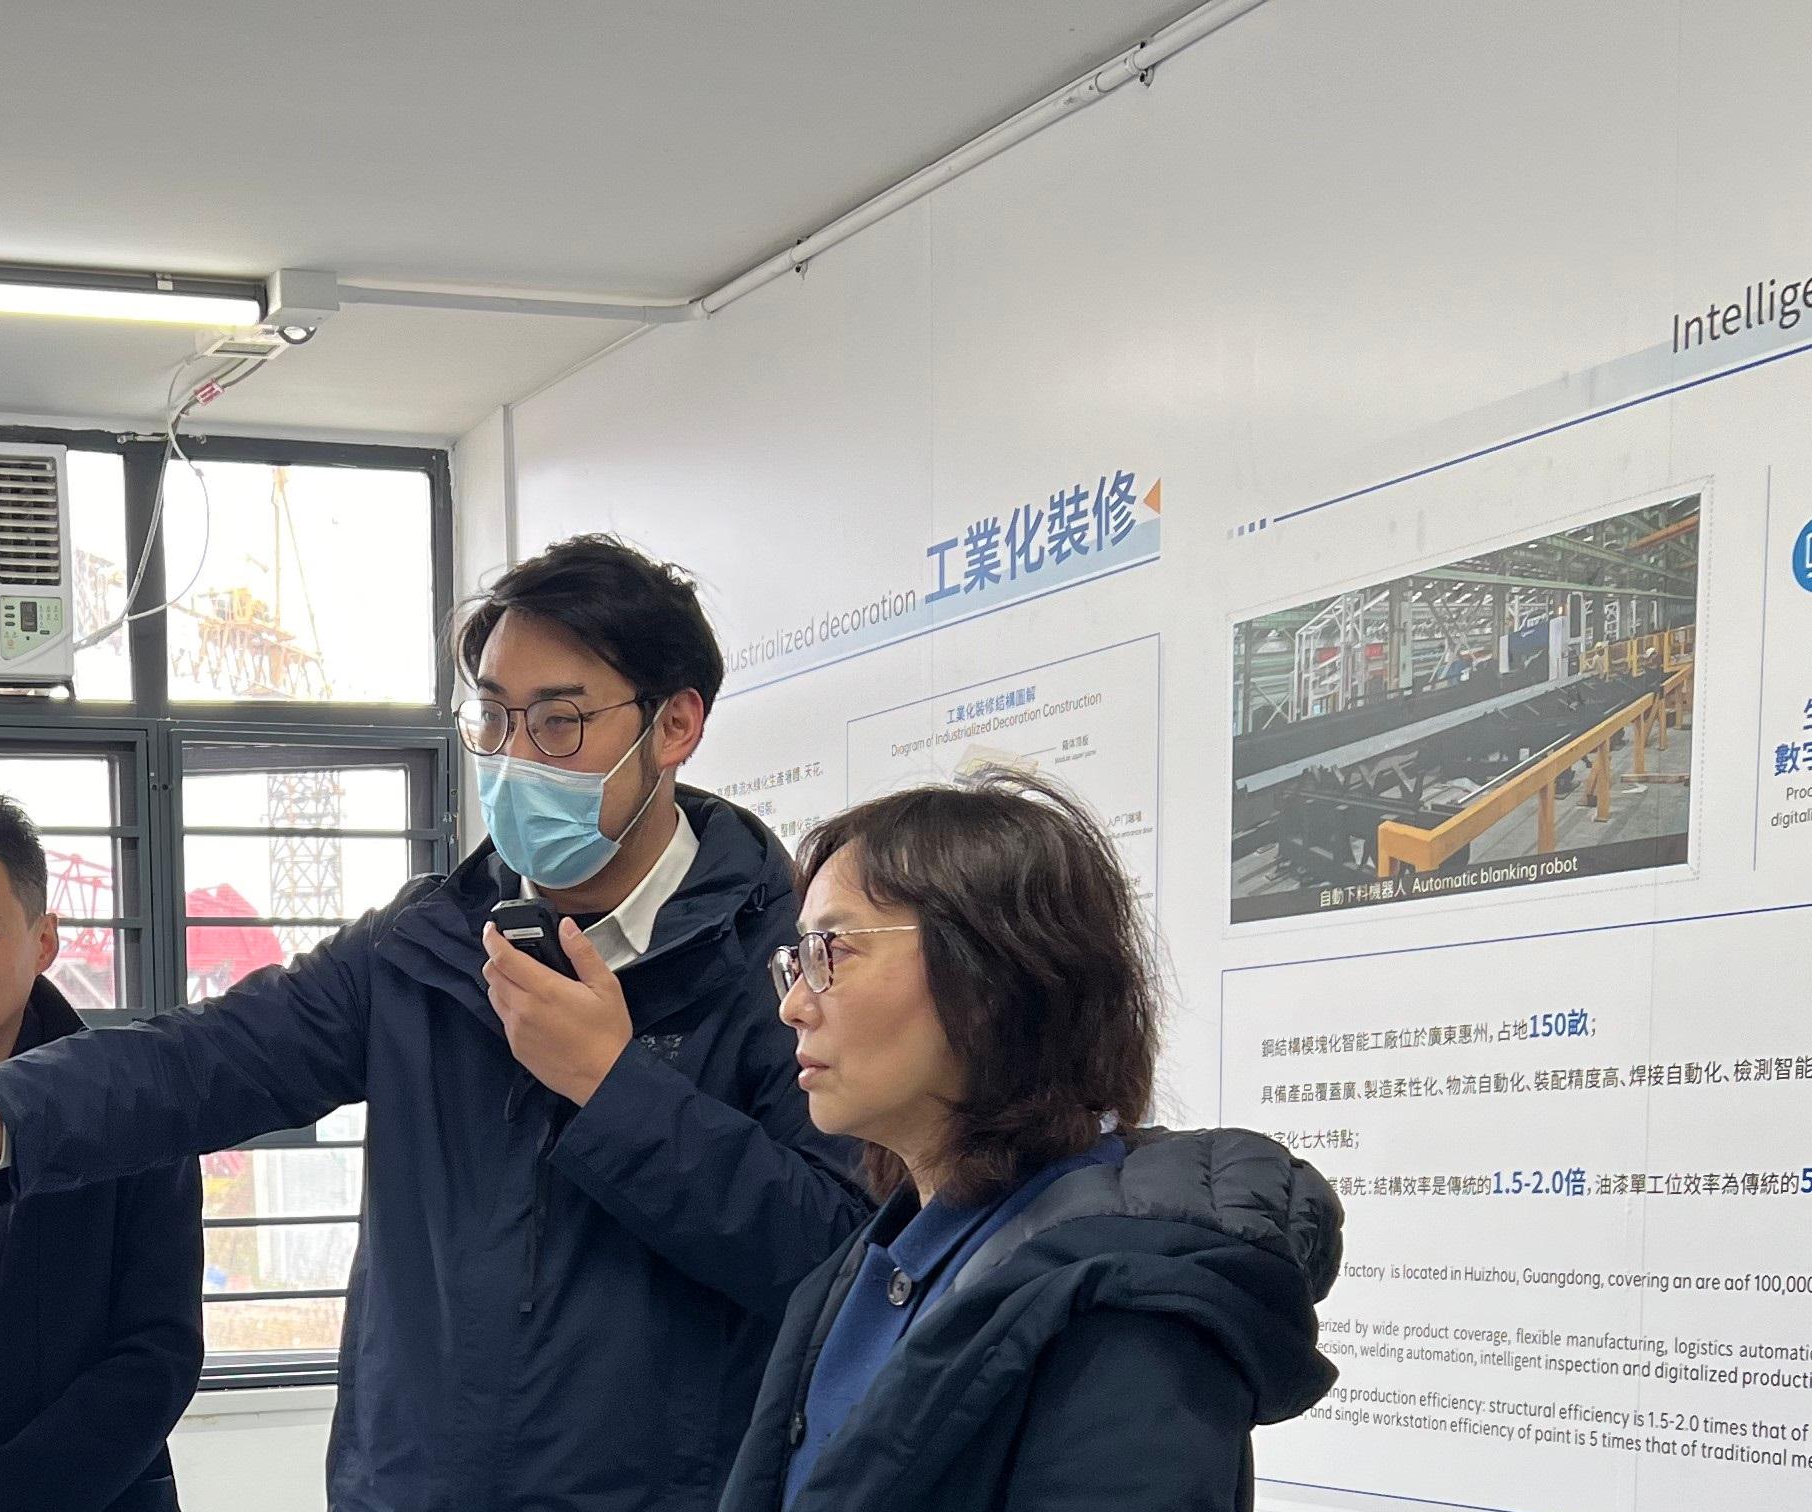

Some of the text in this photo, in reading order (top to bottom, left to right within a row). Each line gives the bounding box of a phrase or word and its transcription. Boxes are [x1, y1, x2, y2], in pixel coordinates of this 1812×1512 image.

[722, 469, 1138, 674] dustrialized decoration 工業化裝修
[891, 739, 925, 758] Diagram
[935, 719, 992, 745] Industrialized
[992, 708, 1041, 731] Decoration
[1043, 691, 1102, 718] Construction
[1320, 855, 1578, 907] 自動下料機器人 Automatic blanking robot
[1344, 1262, 1385, 1282] factory
[1390, 1264, 1400, 1279] is
[1403, 1264, 1447, 1281] located
[1450, 1266, 1461, 1281] in
[1464, 1267, 1519, 1286] Huizhou,
[1523, 1268, 1604, 1290] Guangdong,
[1608, 1272, 1669, 1292] covering
[1673, 1275, 1692, 1289] an
[1696, 1276, 1720, 1290] are
[1725, 1273, 1751, 1291] aof
[1317, 1342, 1357, 1358] ecision,
[1360, 1343, 1403, 1362] welding
[1406, 1347, 1477, 1366] automation,
[1480, 1350, 1543, 1371] intelligent
[1545, 1356, 1618, 1376] inspection
[1622, 1361, 1651, 1377] and
[1654, 1362, 1738, 1383] digitalized
[1355, 1319, 1368, 1338] by
[1372, 1320, 1399, 1337] wide
[1404, 1323, 1449, 1341] product
[1454, 1329, 1511, 1347] coverage,
[1516, 1327, 1561, 1346] flexible
[1566, 1332, 1667, 1357] manufacturing,
[1674, 1337, 1733, 1359] logistics
[1739, 1344, 1812, 1362] automati
[1310, 1406, 1332, 1420] and
[1335, 1406, 1370, 1426] single
[1373, 1412, 1447, 1431] workstation
[1450, 1417, 1513, 1441] efficiency
[1517, 1424, 1533, 1442] of
[1535, 1427, 1571, 1444] paint
[1575, 1429, 1586, 1445] is
[1589, 1430, 1598, 1447] 5
[1602, 1432, 1641, 1451] times
[1645, 1436, 1677, 1456] that
[1681, 1440, 1697, 1457] of
[1701, 1442, 1787, 1467] traditional
[1350, 1387, 1415, 1405] production
[1419, 1391, 1486, 1415] efficiency:
[1489, 1399, 1555, 1418] structural
[1559, 1404, 1629, 1429] efficiency
[1633, 1410, 1645, 1427] is
[1648, 1411, 1699, 1432] 1.5-2.0
[1703, 1416, 1747, 1437] times
[1752, 1420, 1786, 1440] that
[1791, 1424, 1810, 1442] of
